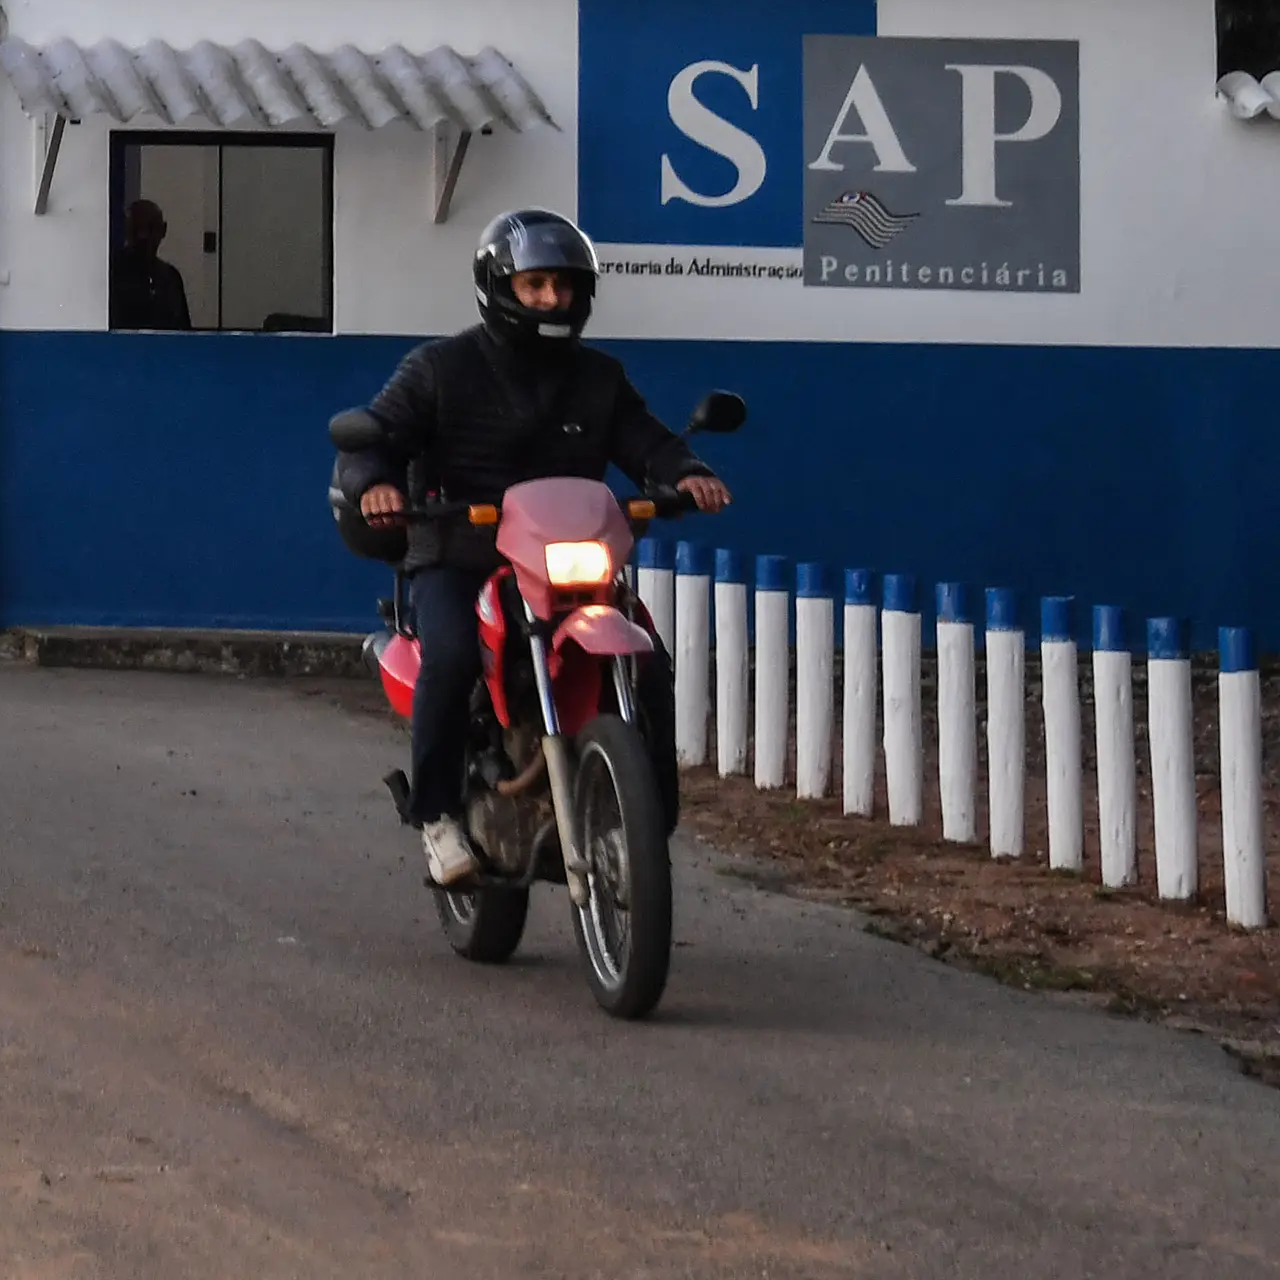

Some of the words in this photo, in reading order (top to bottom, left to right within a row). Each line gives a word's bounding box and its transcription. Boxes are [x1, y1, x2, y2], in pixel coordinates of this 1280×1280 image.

[665, 258, 683, 275] da
[686, 258, 803, 280] Administração
[820, 255, 1067, 287] Penitenciária
